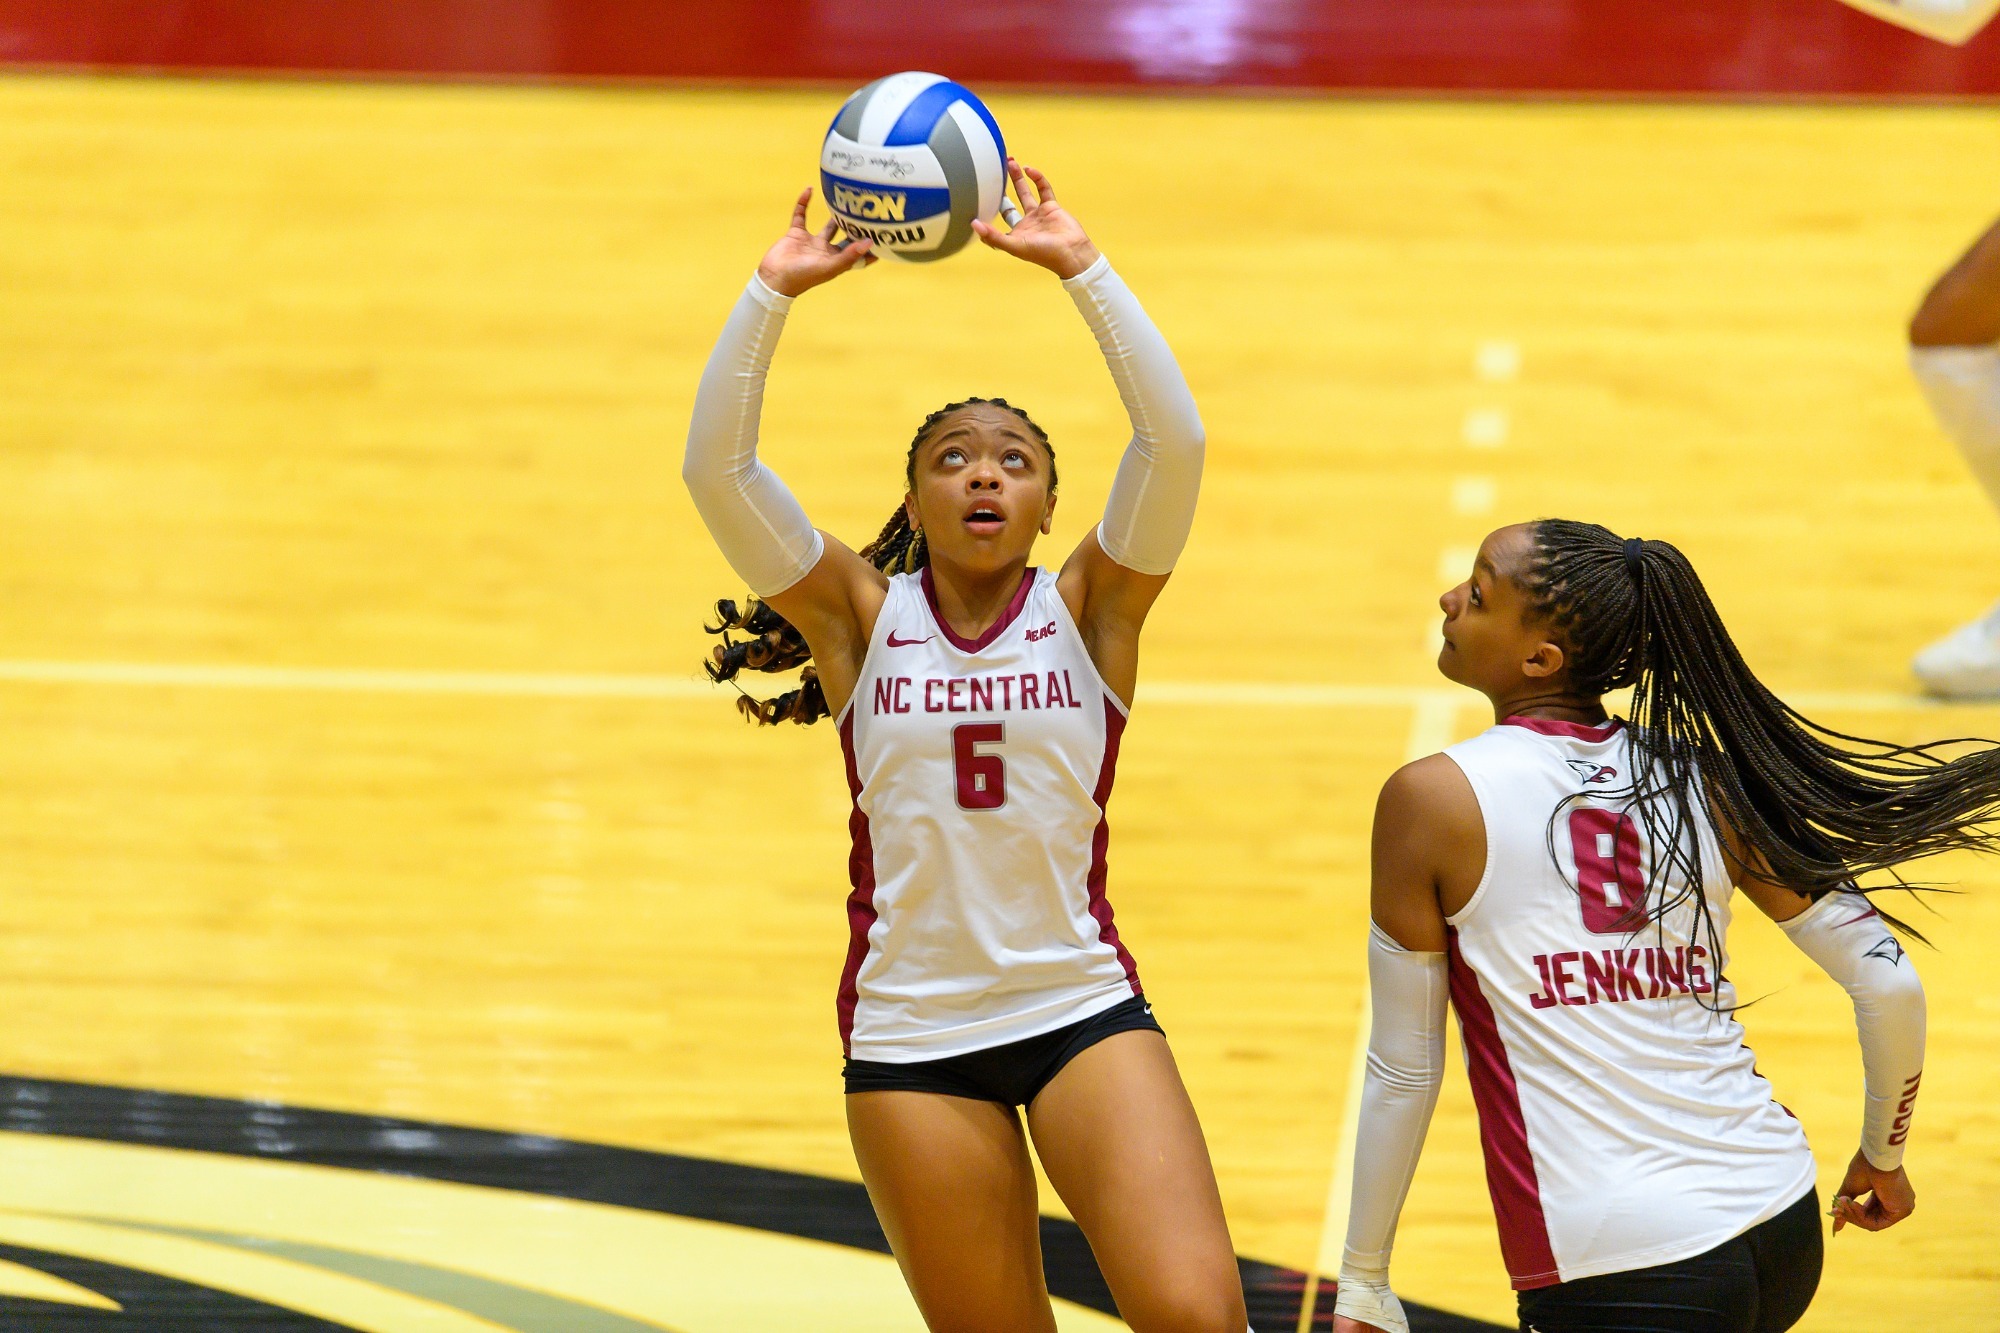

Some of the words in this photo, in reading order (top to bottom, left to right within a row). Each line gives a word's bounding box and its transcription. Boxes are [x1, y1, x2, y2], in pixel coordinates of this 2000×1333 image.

[833, 185, 906, 222] NCAA
[874, 677, 911, 715] NC
[925, 669, 1082, 713] CENTRAL
[950, 720, 1008, 812] 6
[1568, 806, 1650, 937] 8
[1529, 945, 1713, 1010] JENKINS
